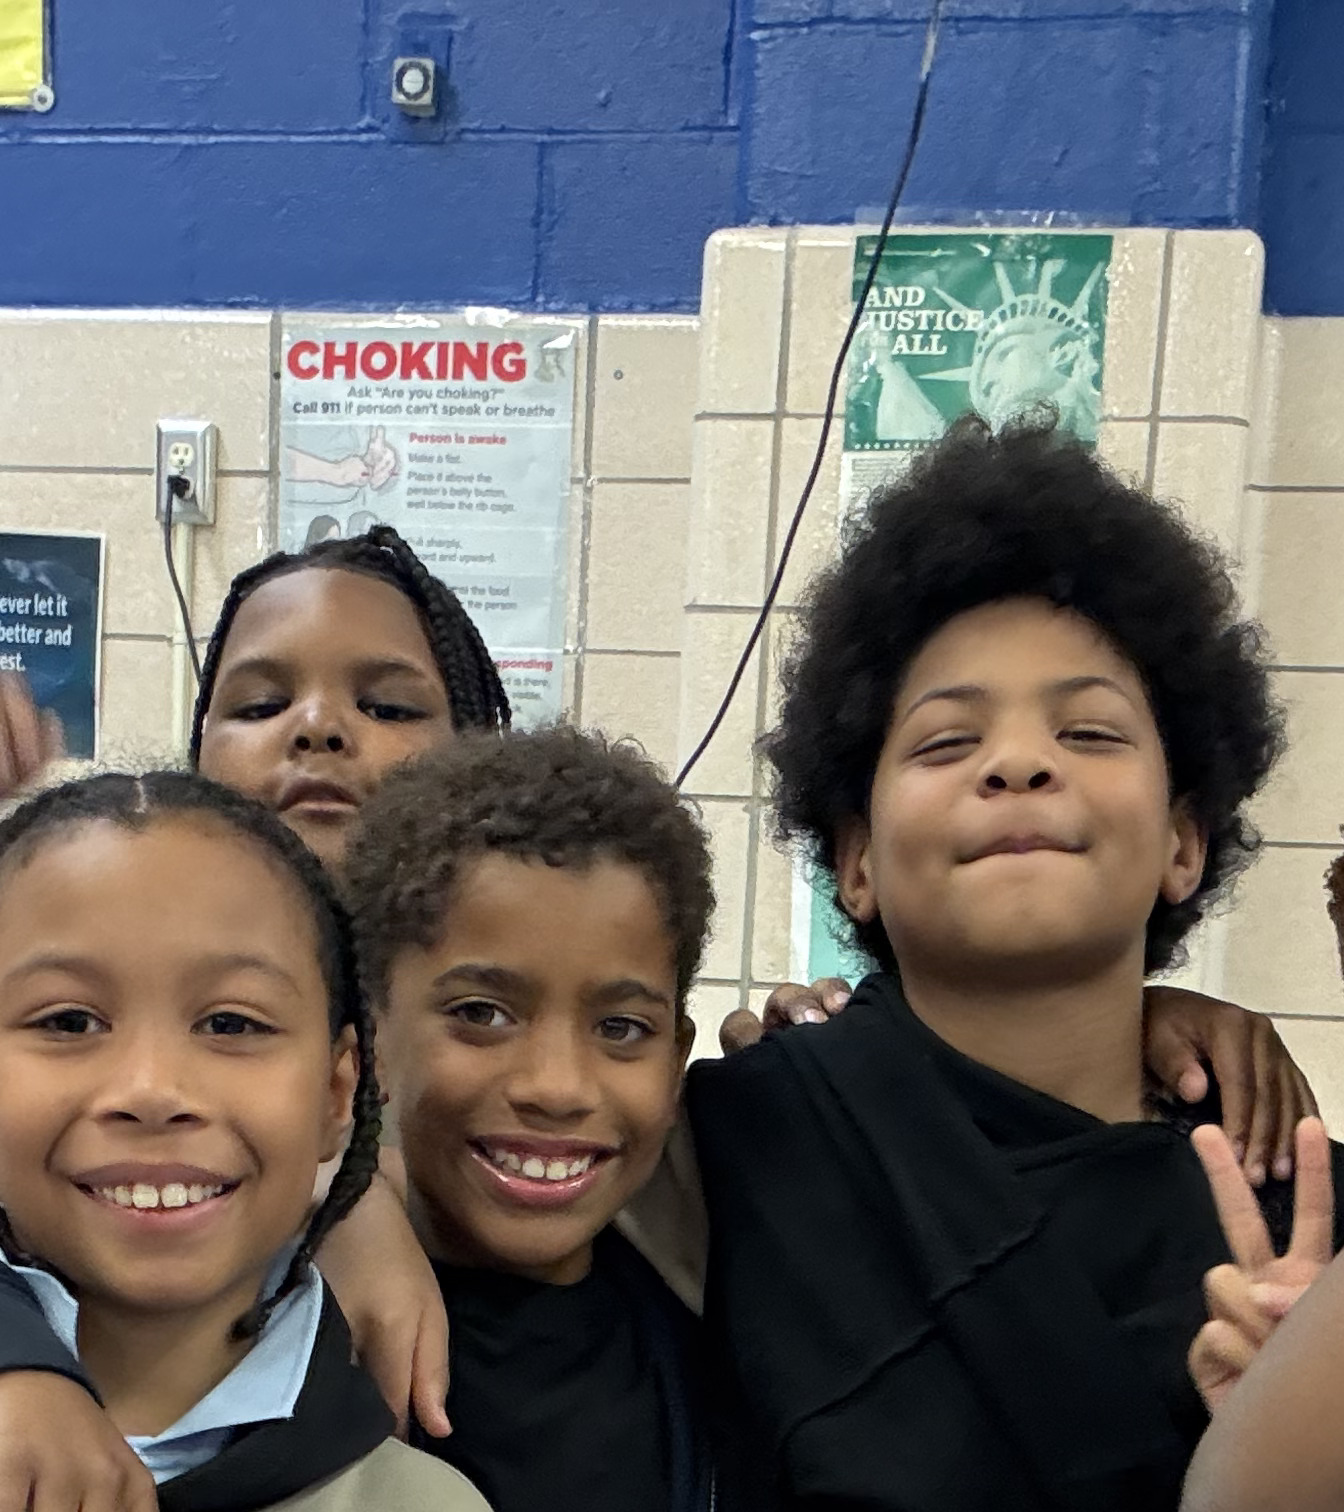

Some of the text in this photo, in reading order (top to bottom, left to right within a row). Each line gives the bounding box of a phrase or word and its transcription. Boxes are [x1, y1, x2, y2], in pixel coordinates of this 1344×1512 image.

[866, 286, 926, 308] AND
[864, 308, 985, 332] JUSTICE
[892, 334, 948, 355] ALL
[287, 341, 527, 382] CHOKING
[348, 385, 372, 399] Ask
[408, 388, 433, 401] you
[293, 401, 556, 417] Call 911 if person can't speak or breathe
[34, 593, 54, 616] let
[56, 593, 68, 617] it
[44, 623, 74, 646] and
